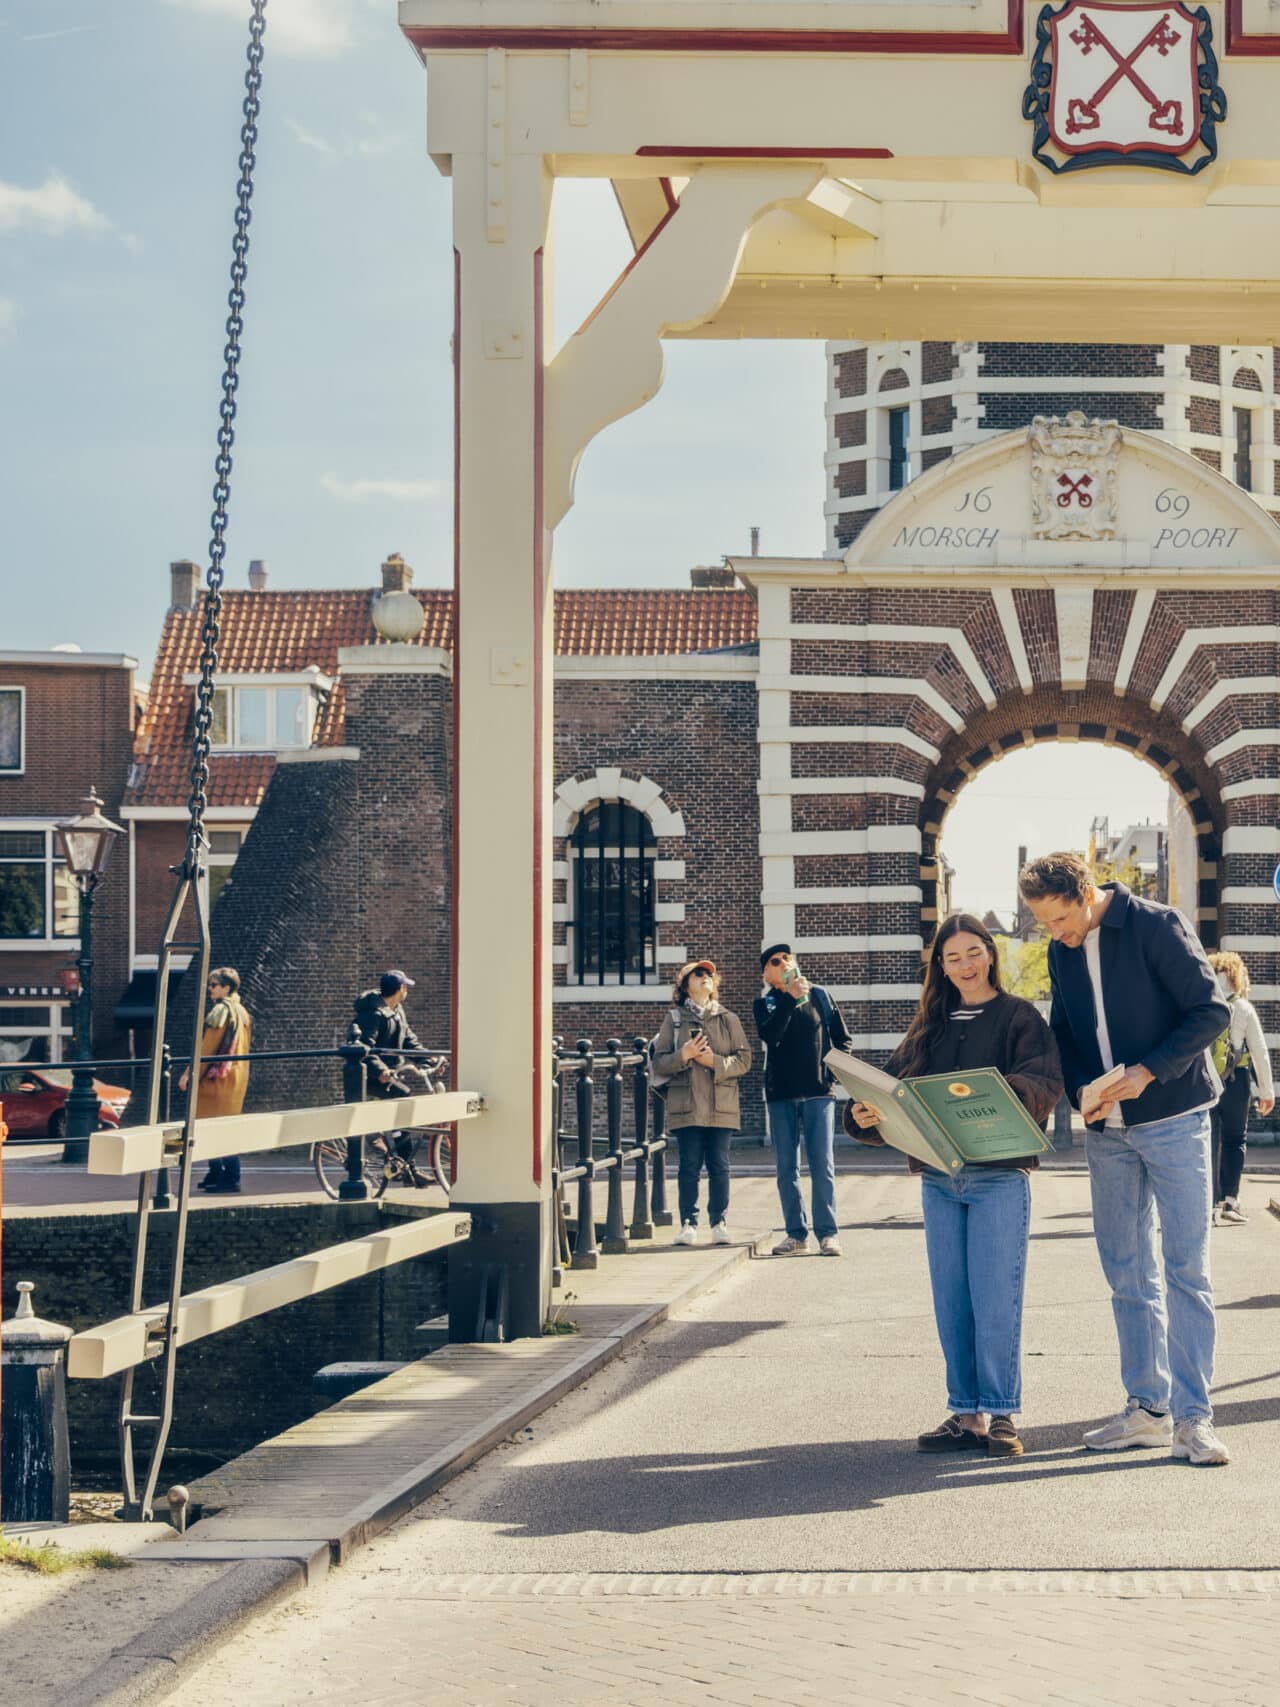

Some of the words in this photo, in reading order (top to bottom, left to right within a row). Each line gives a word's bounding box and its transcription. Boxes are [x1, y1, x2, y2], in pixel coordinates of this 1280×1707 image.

[953, 486, 994, 513] 16
[1155, 487, 1190, 520] 69
[892, 526, 999, 548] MORSCH
[1153, 527, 1244, 549] POORT
[7, 987, 69, 996] VENEM
[956, 1105, 998, 1120] LEIDEN
